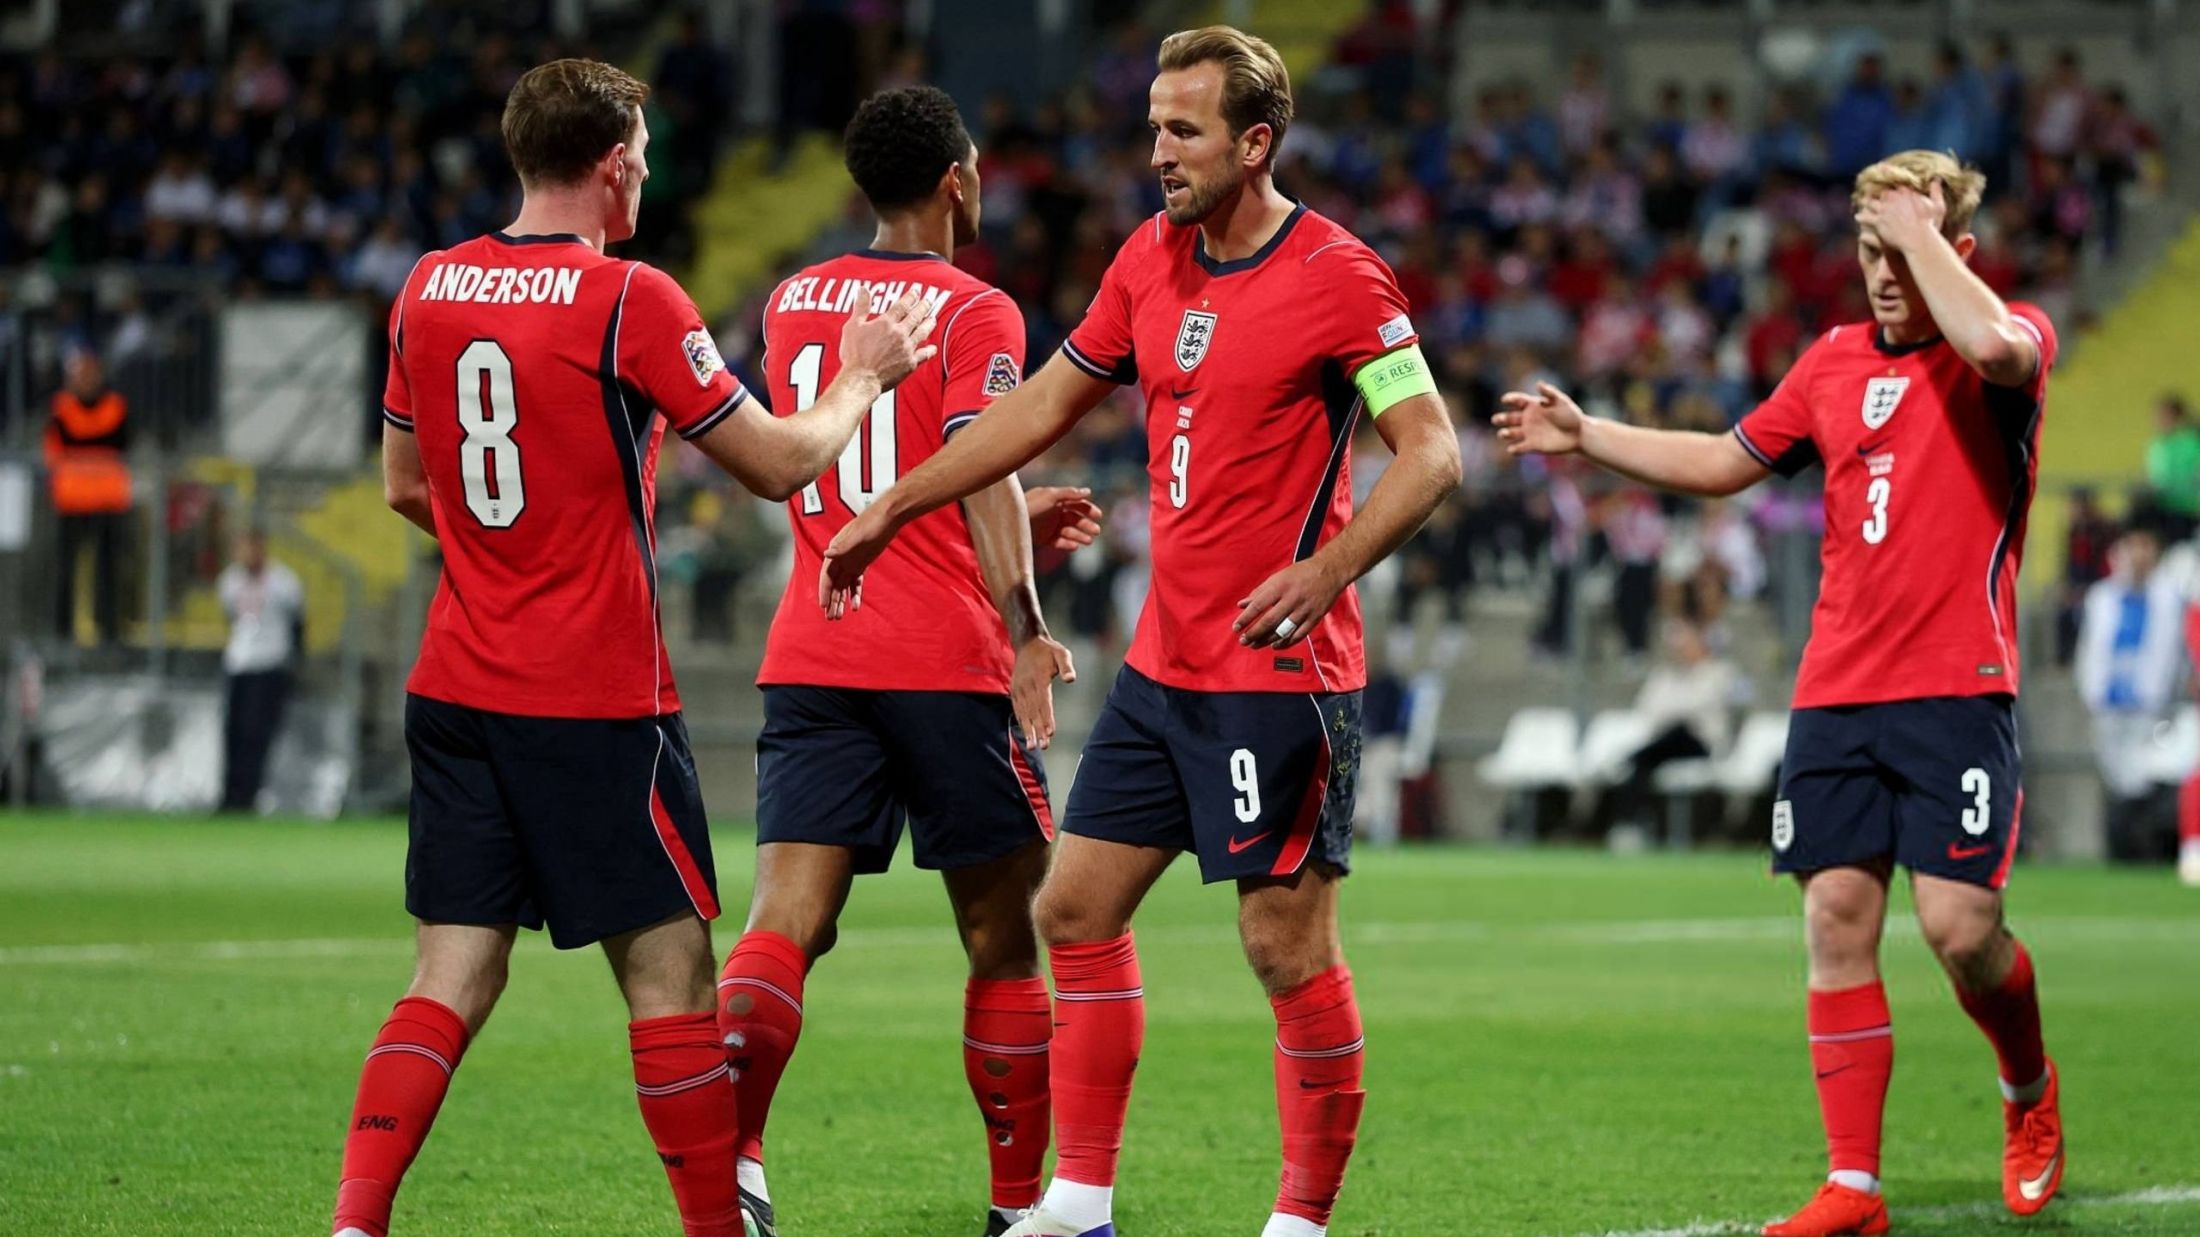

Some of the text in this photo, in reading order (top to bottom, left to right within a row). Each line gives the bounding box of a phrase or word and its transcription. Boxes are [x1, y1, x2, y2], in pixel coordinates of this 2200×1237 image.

[419, 263, 583, 305] ANDERSON
[455, 338, 526, 529] 8
[788, 343, 899, 518] 10
[1169, 433, 1191, 510] 9
[1862, 477, 1891, 545] 3
[1230, 748, 1261, 823] 9
[1961, 767, 1990, 835] 3
[357, 1115, 399, 1131] ENG
